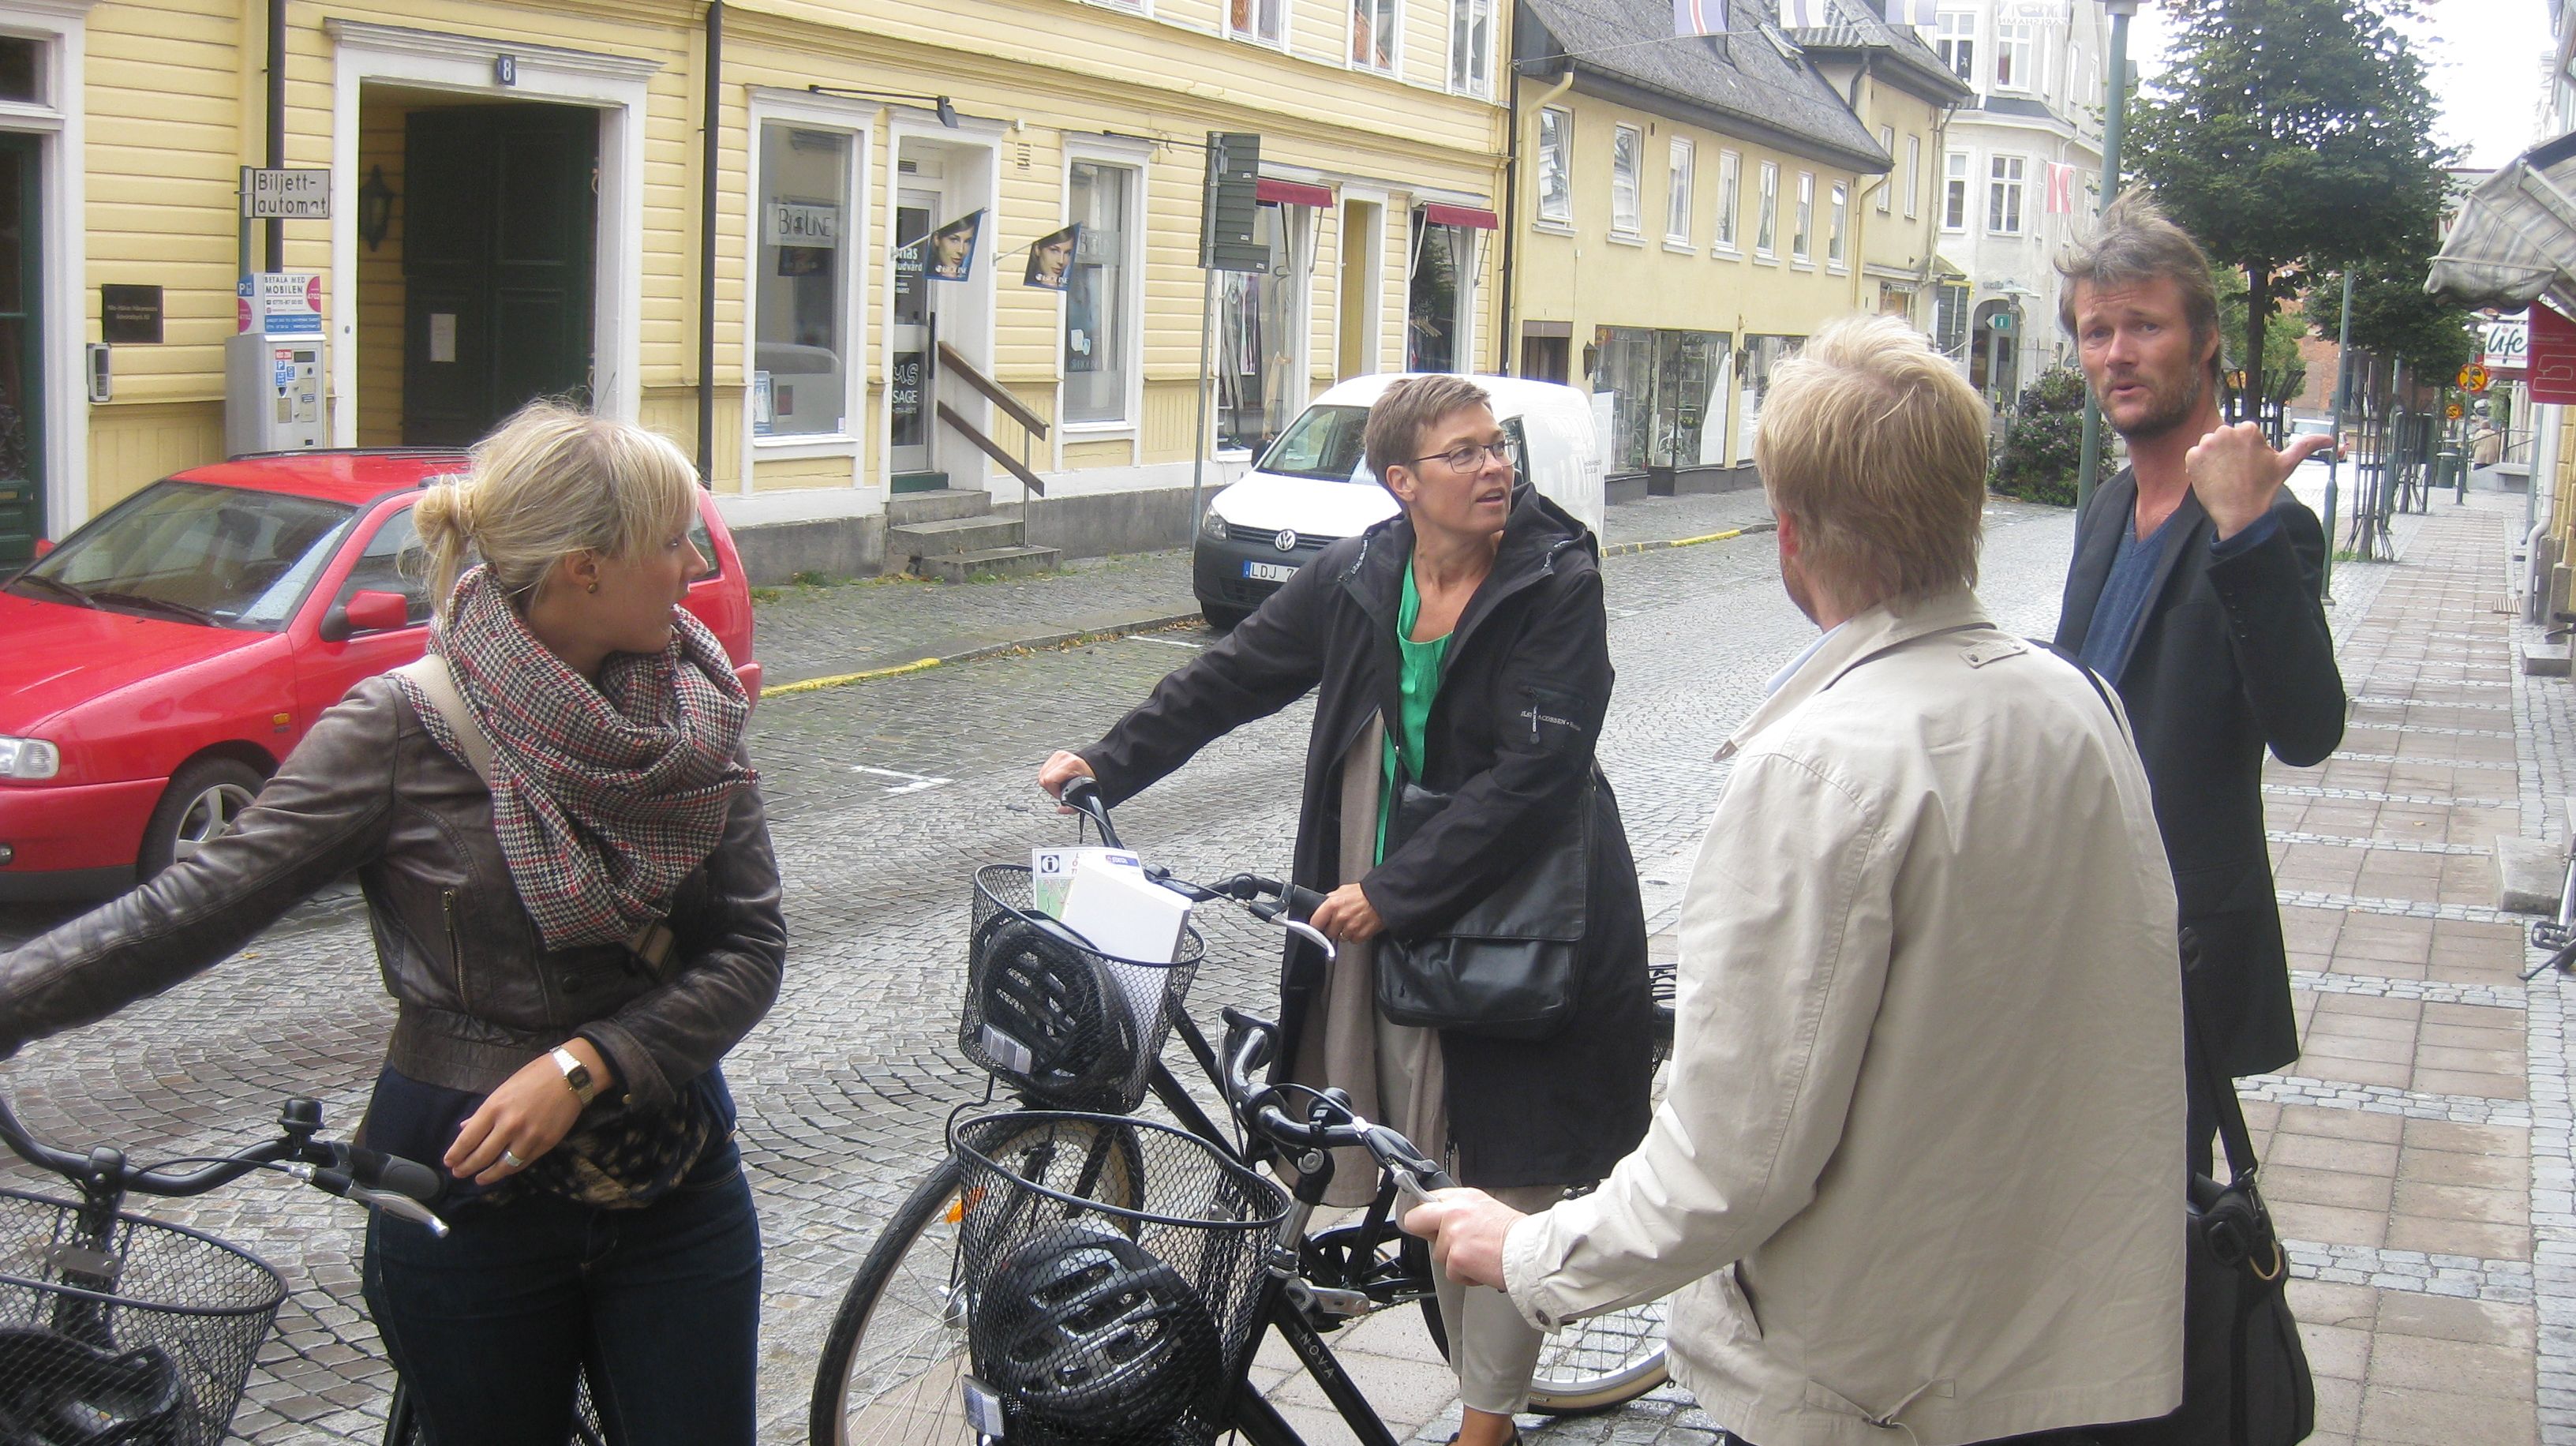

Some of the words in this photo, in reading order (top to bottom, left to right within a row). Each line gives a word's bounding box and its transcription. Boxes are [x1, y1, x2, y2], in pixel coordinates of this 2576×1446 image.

[503, 58, 512, 82] 8
[257, 172, 316, 195] Biljett-
[265, 286, 303, 294] MOBILEN
[2488, 325, 2528, 364] life
[893, 390, 918, 403] SAGE
[1251, 564, 1277, 579] LDJ
[1299, 1332, 1335, 1379] NOVA
